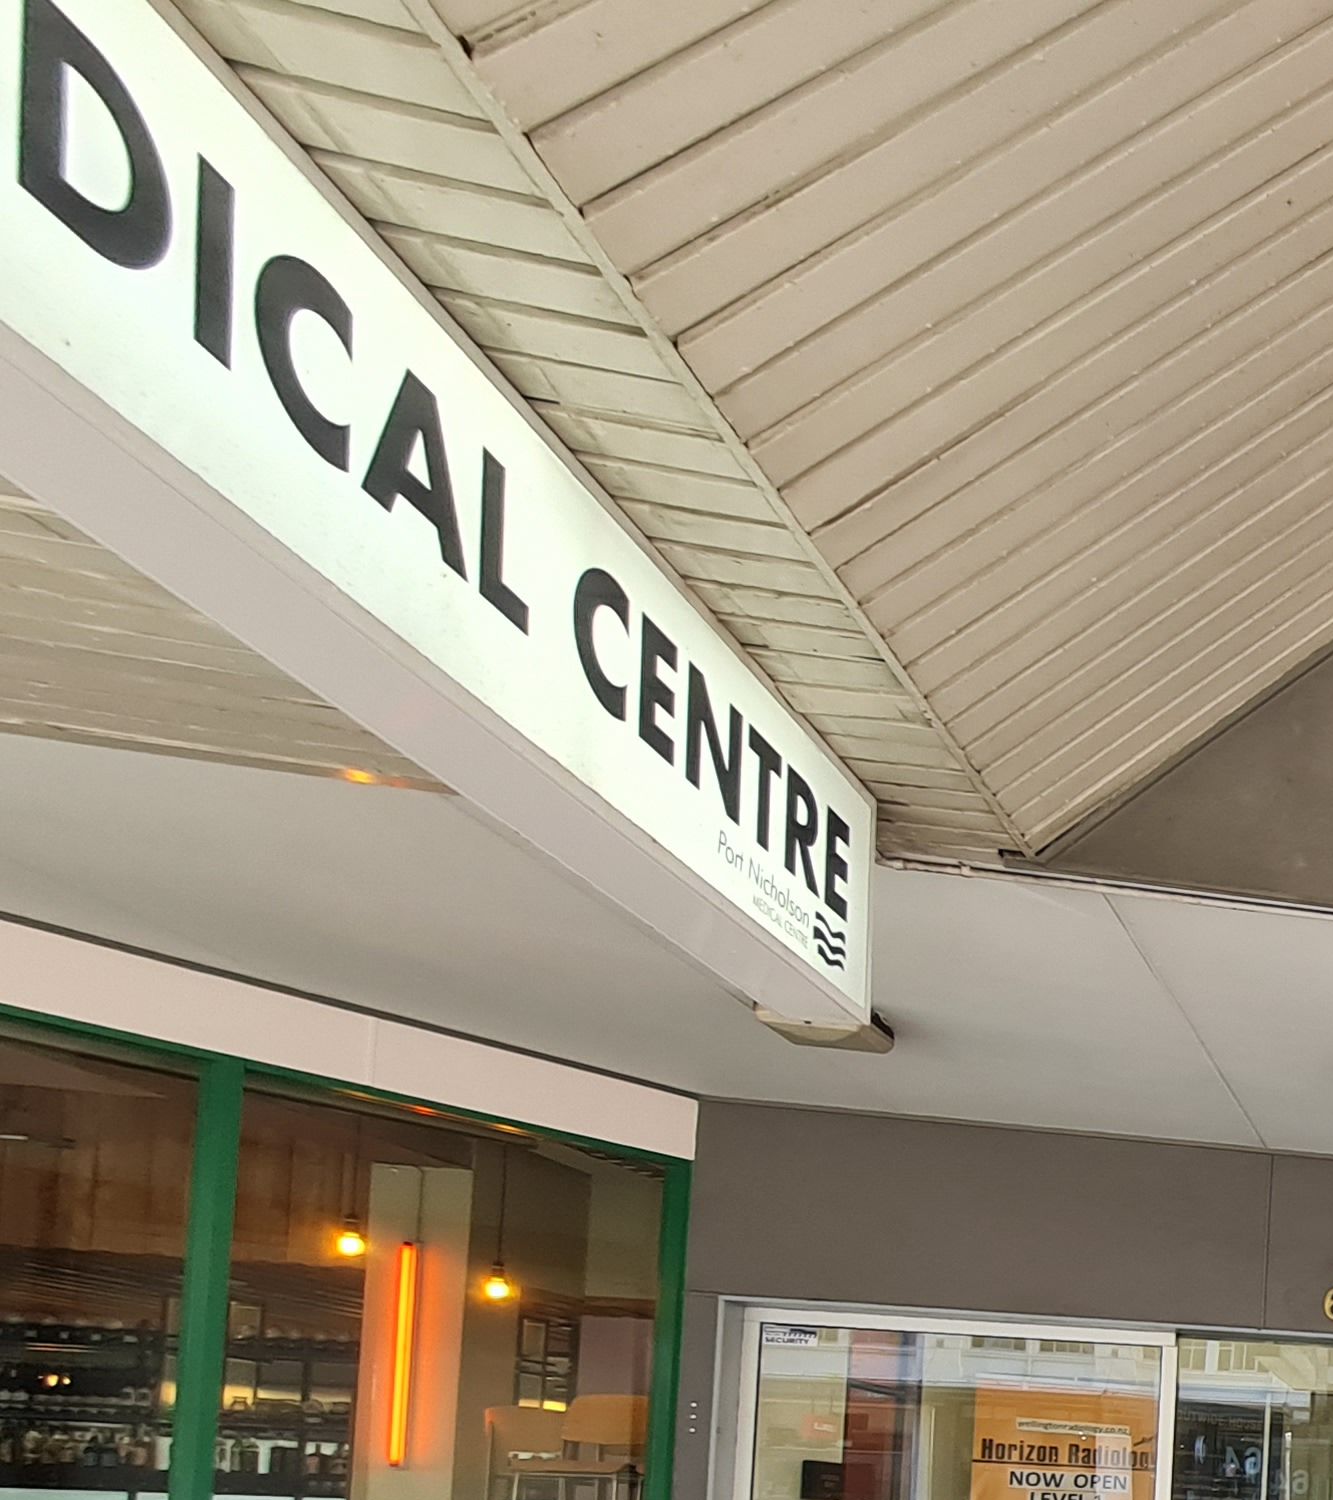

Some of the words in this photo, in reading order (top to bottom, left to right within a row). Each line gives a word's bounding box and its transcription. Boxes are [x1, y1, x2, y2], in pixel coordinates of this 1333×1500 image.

[16, 0, 530, 637] DICAL
[573, 567, 851, 923] CENTRE
[717, 830, 744, 872] Port
[748, 857, 811, 928] Nicholson
[764, 1336, 810, 1345] SECURITY
[980, 1437, 1059, 1463] Horizon
[1009, 1470, 1064, 1488] NOW
[1074, 1473, 1127, 1490] OPEN
